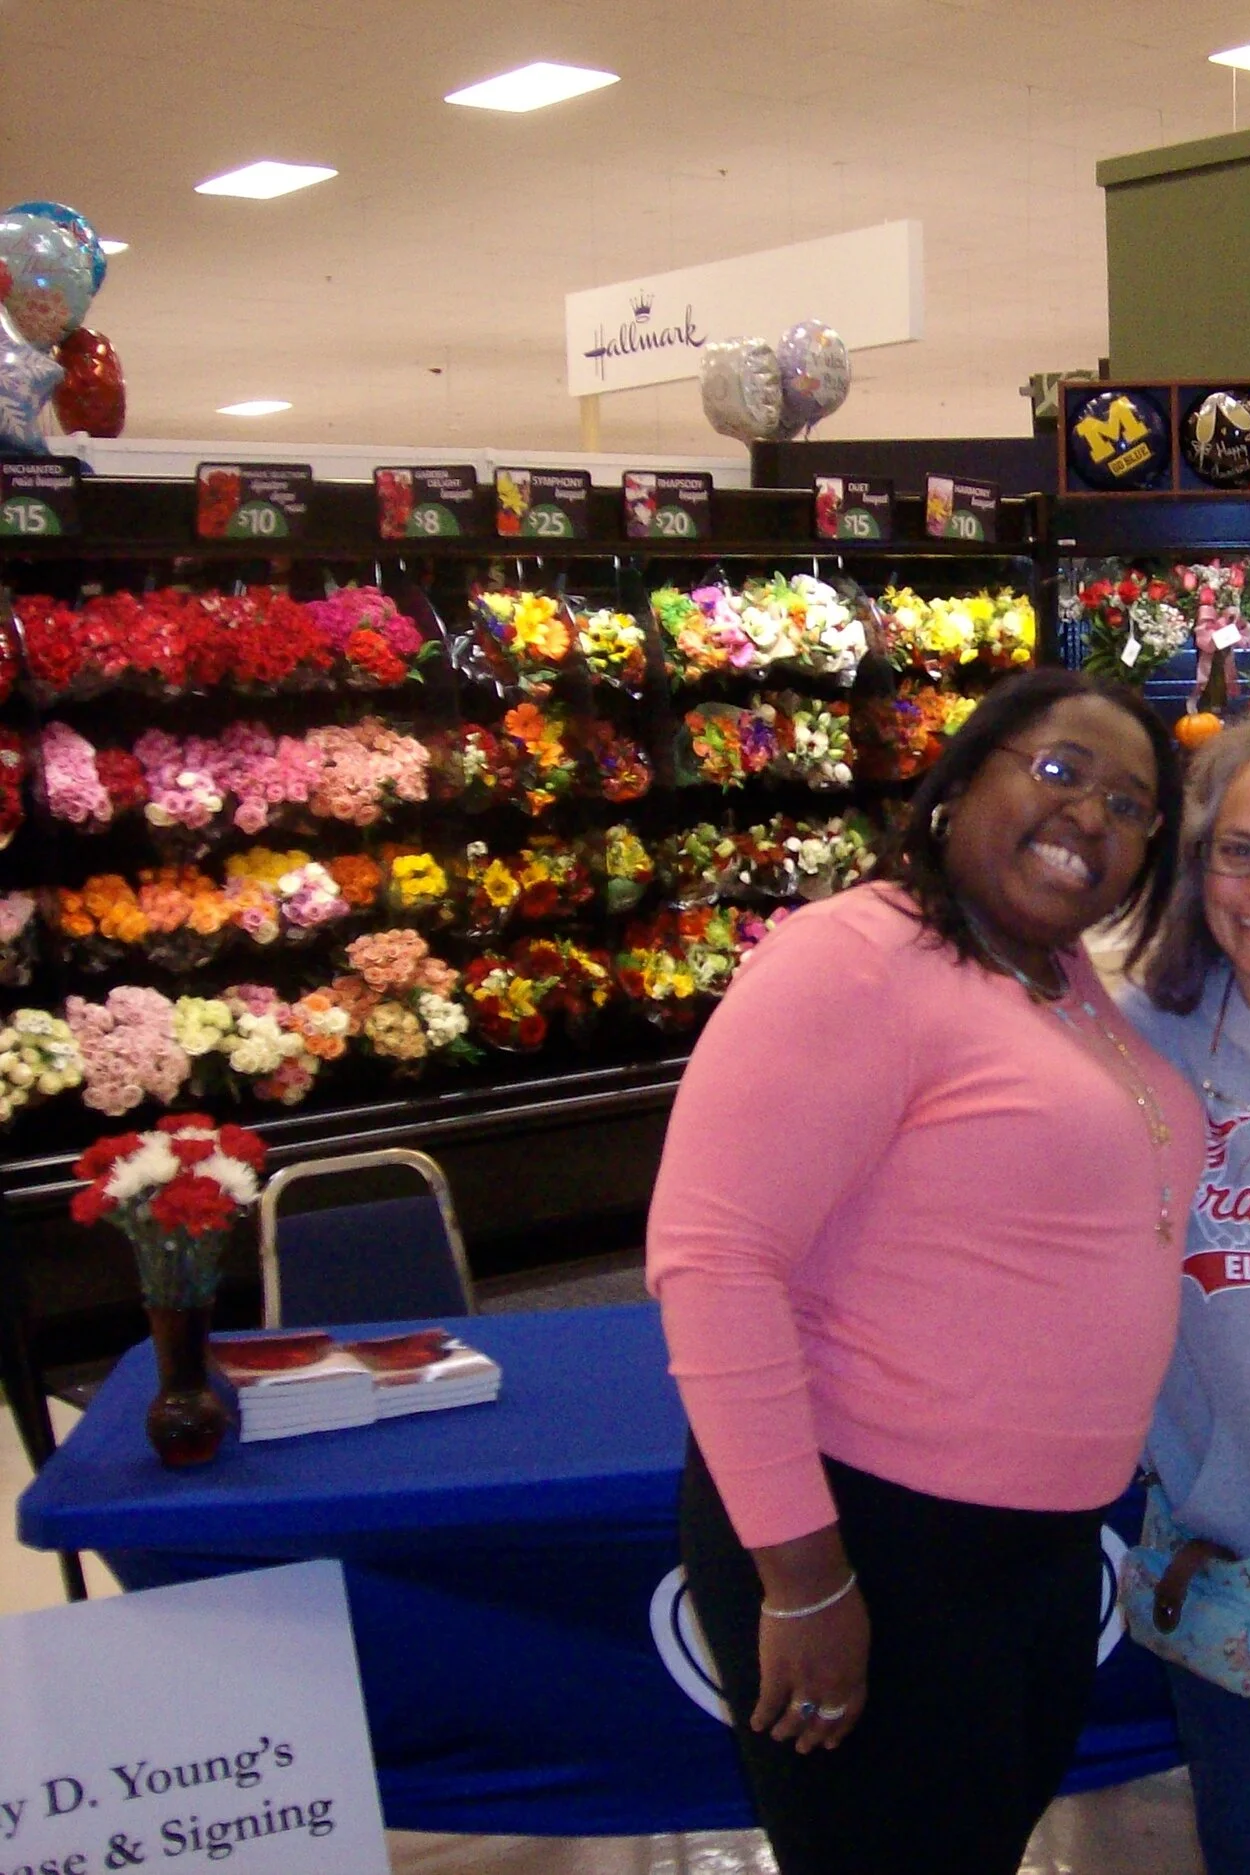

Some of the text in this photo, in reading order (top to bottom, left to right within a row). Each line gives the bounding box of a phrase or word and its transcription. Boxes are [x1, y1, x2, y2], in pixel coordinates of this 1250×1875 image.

[584, 304, 709, 381] Hallmark
[1075, 394, 1149, 464] M
[1214, 440, 1250, 467] Happy
[2, 463, 63, 475] ENCHANTED
[531, 475, 584, 489] SYMPHONY
[847, 482, 870, 493] DUET
[2, 504, 47, 532] $15
[238, 508, 277, 534] $10
[413, 509, 440, 534] $8
[528, 511, 566, 536] $25
[656, 511, 689, 535] $20
[844, 514, 870, 537] $15
[951, 515, 976, 538] $10
[41, 1736, 294, 1818] D. Young's
[104, 1832, 145, 1871] &
[159, 1799, 335, 1861] Signing
